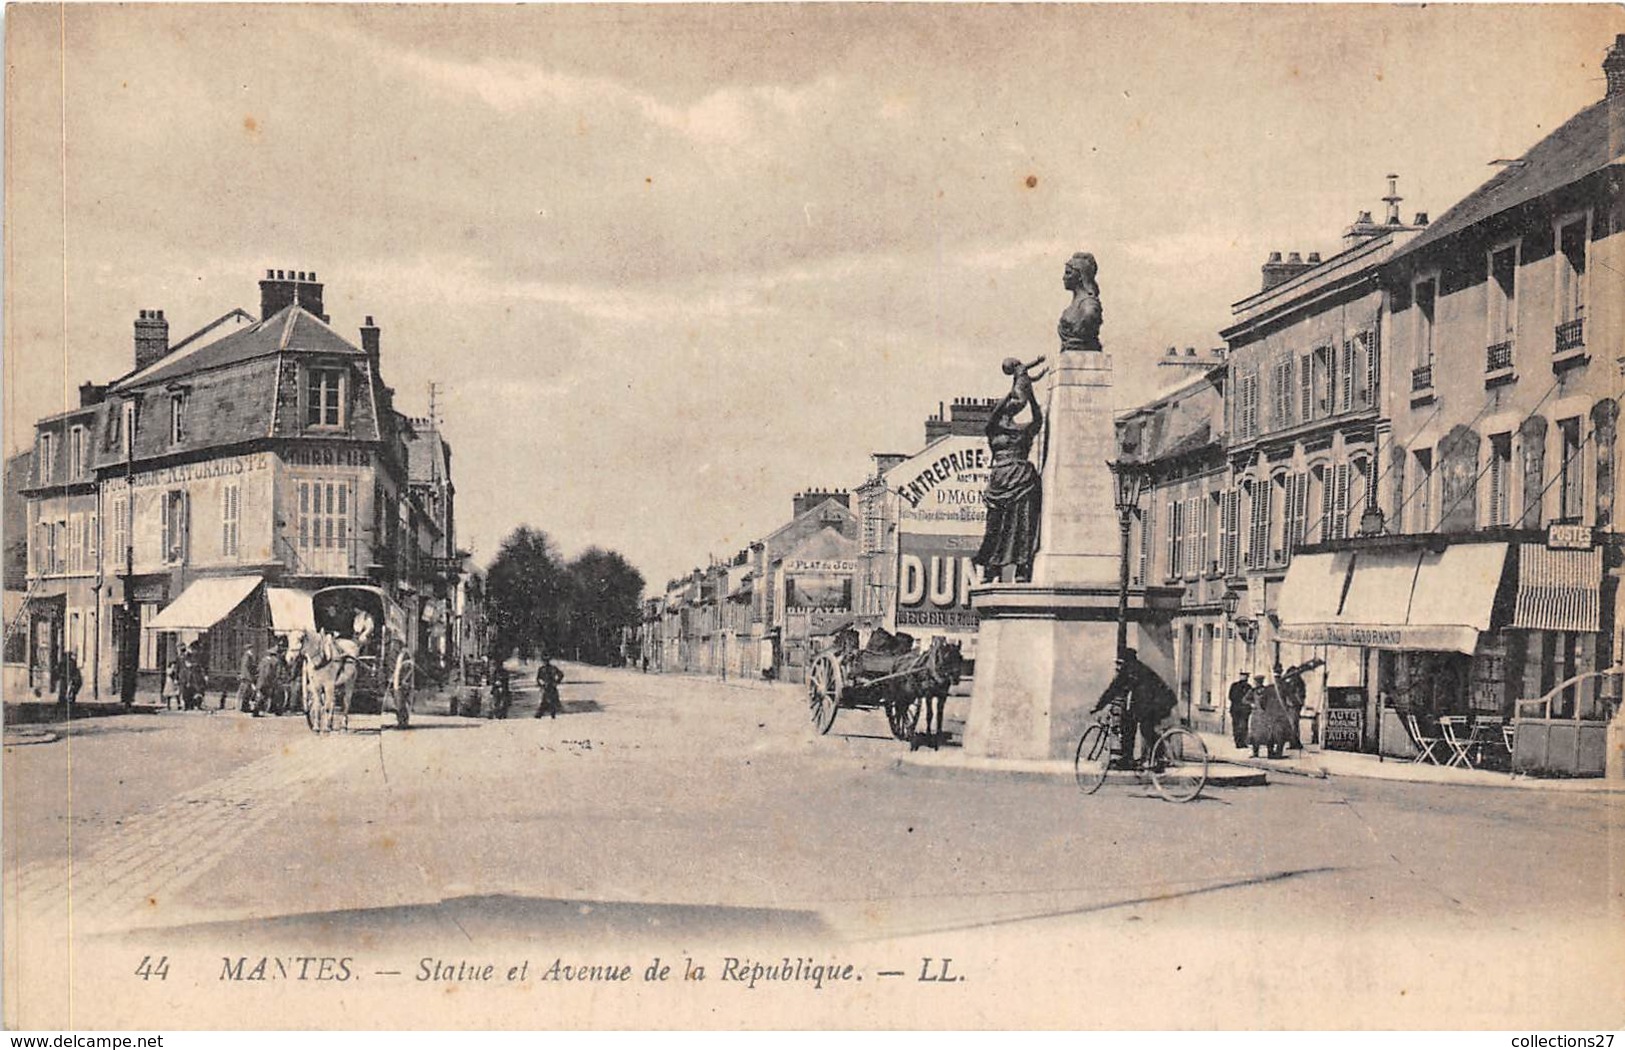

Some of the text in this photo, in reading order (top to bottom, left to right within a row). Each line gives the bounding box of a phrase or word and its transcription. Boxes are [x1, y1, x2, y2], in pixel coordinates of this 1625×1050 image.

[898, 449, 984, 508] ENTREPRISE
[1549, 525, 1592, 542] POSTES
[796, 560, 821, 570] PLAT
[1330, 711, 1357, 720] AUTO
